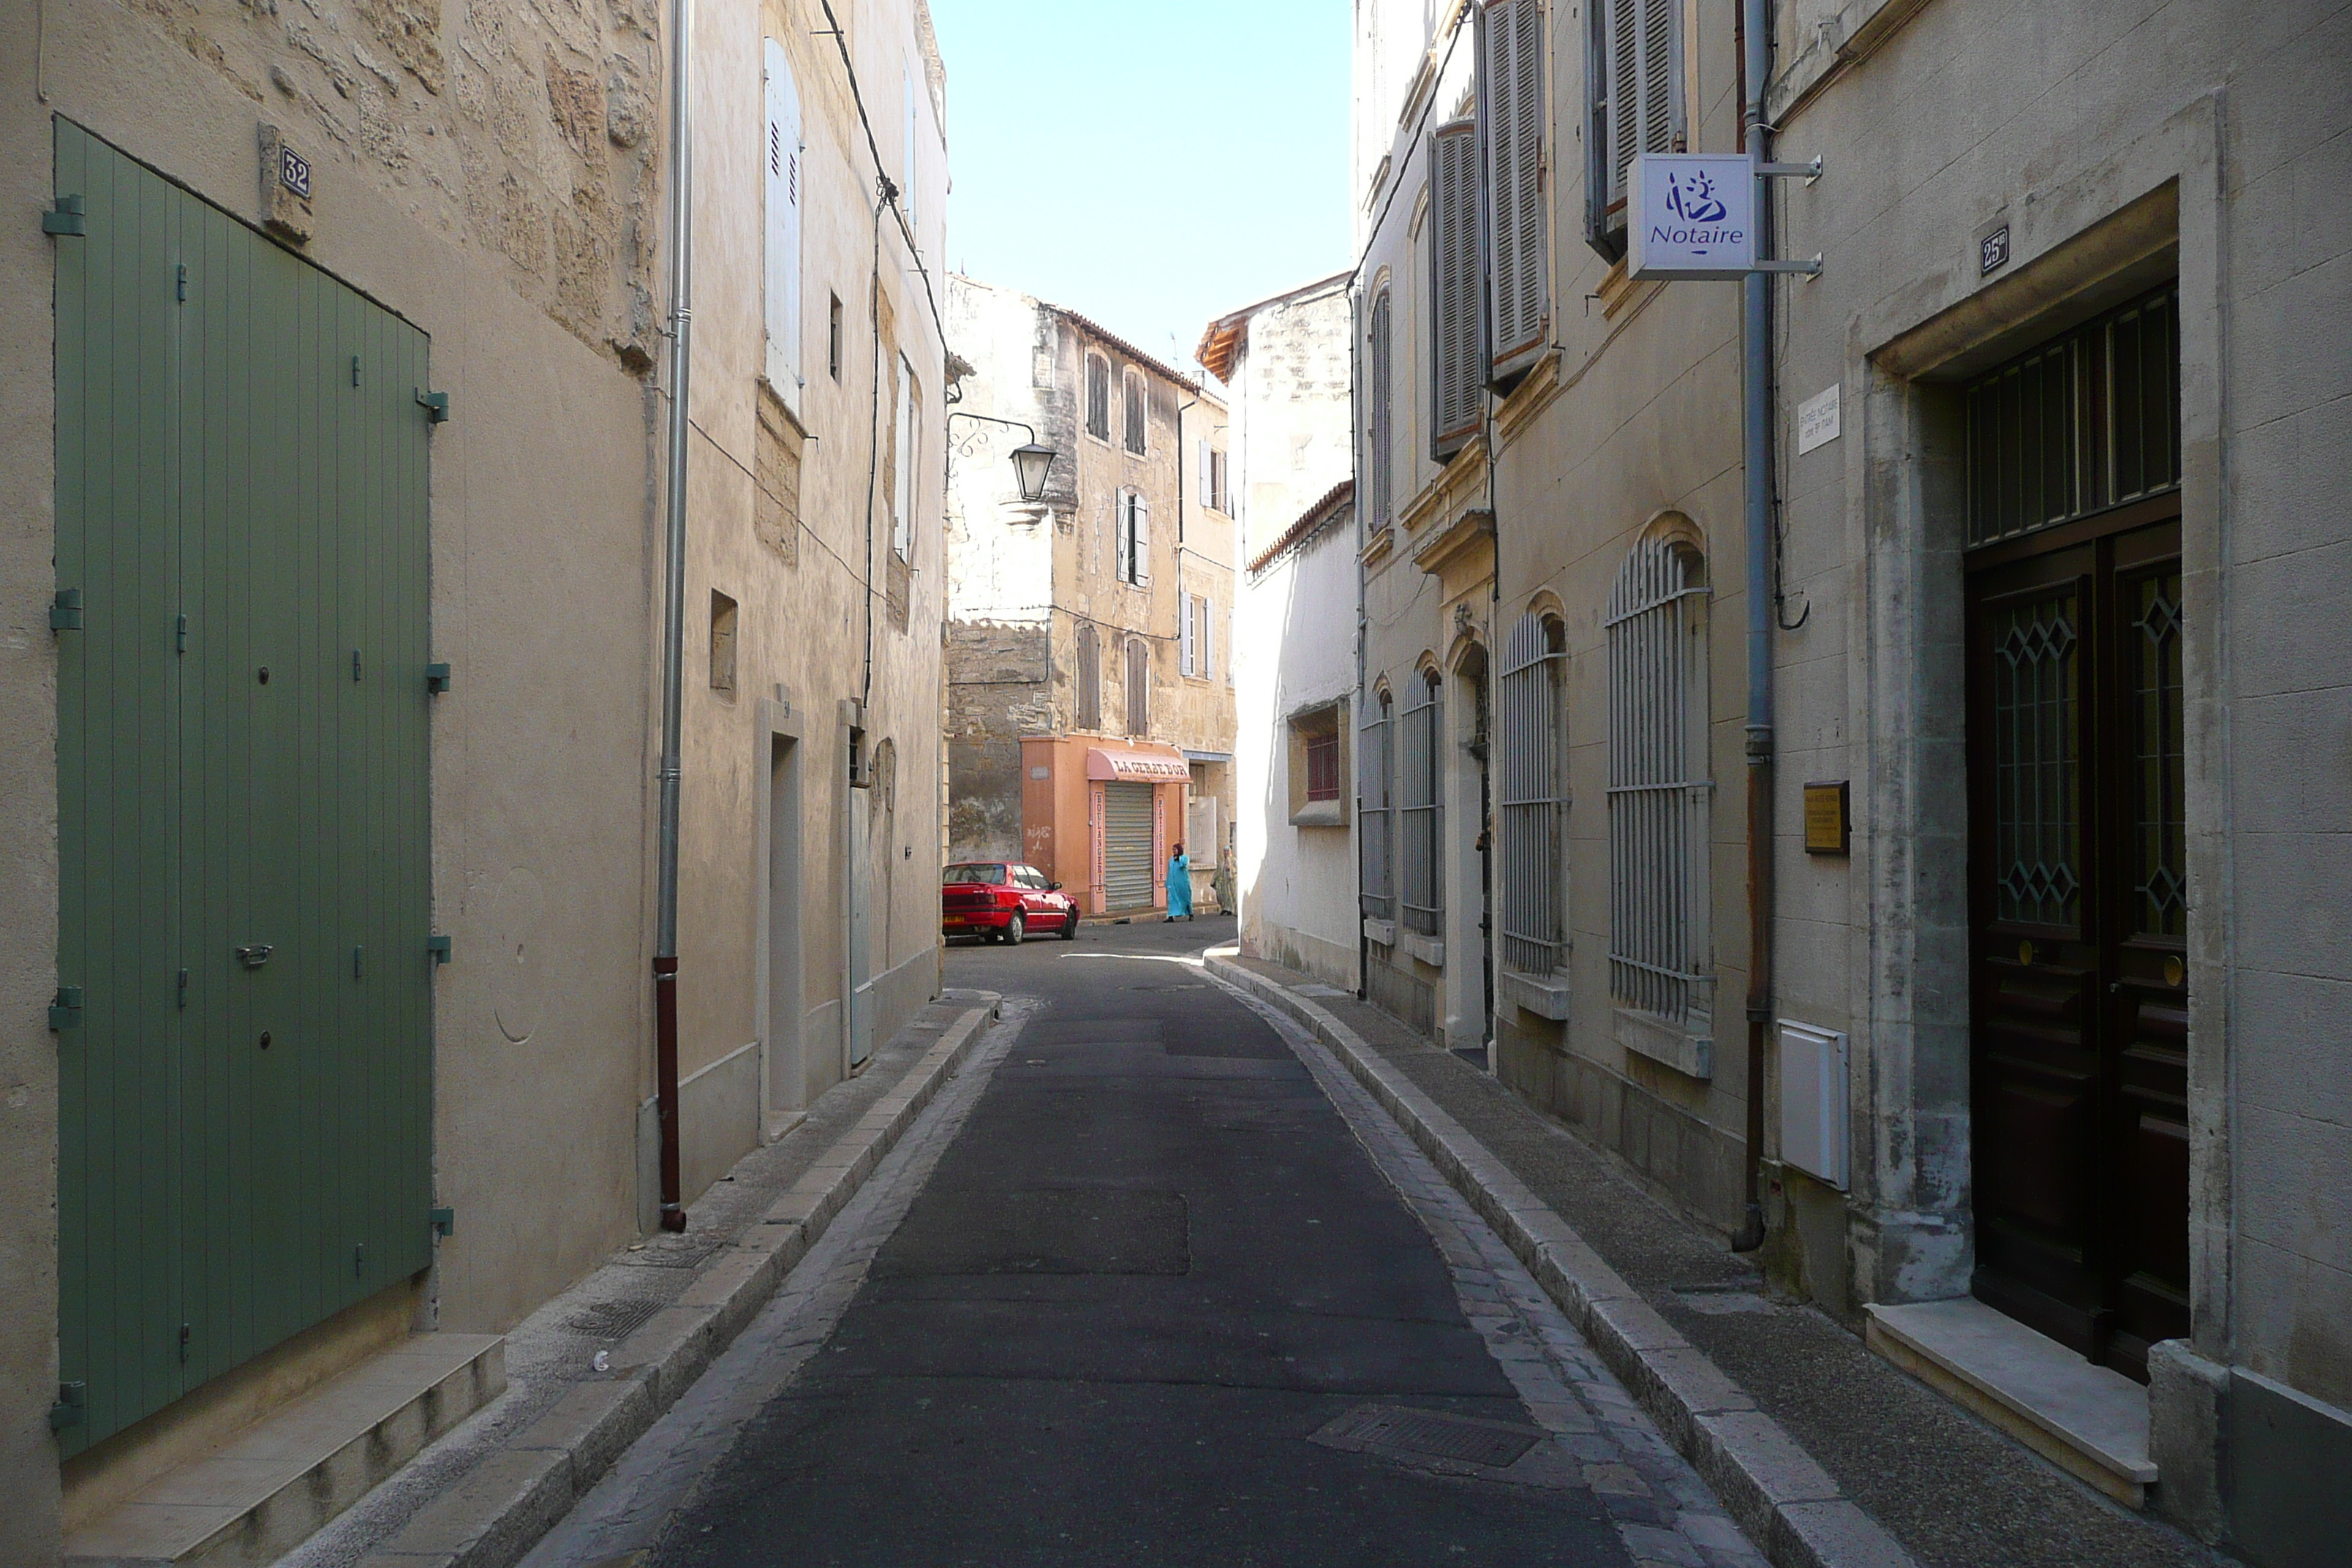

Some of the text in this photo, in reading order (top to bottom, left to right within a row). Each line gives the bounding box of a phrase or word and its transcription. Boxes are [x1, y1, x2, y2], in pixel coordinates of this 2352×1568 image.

[286, 154, 306, 191] 32
[1651, 226, 1743, 244] Notaire
[1984, 237, 1999, 267] 25
[1114, 761, 1131, 772] LA
[1131, 762, 1166, 774] GERBE
